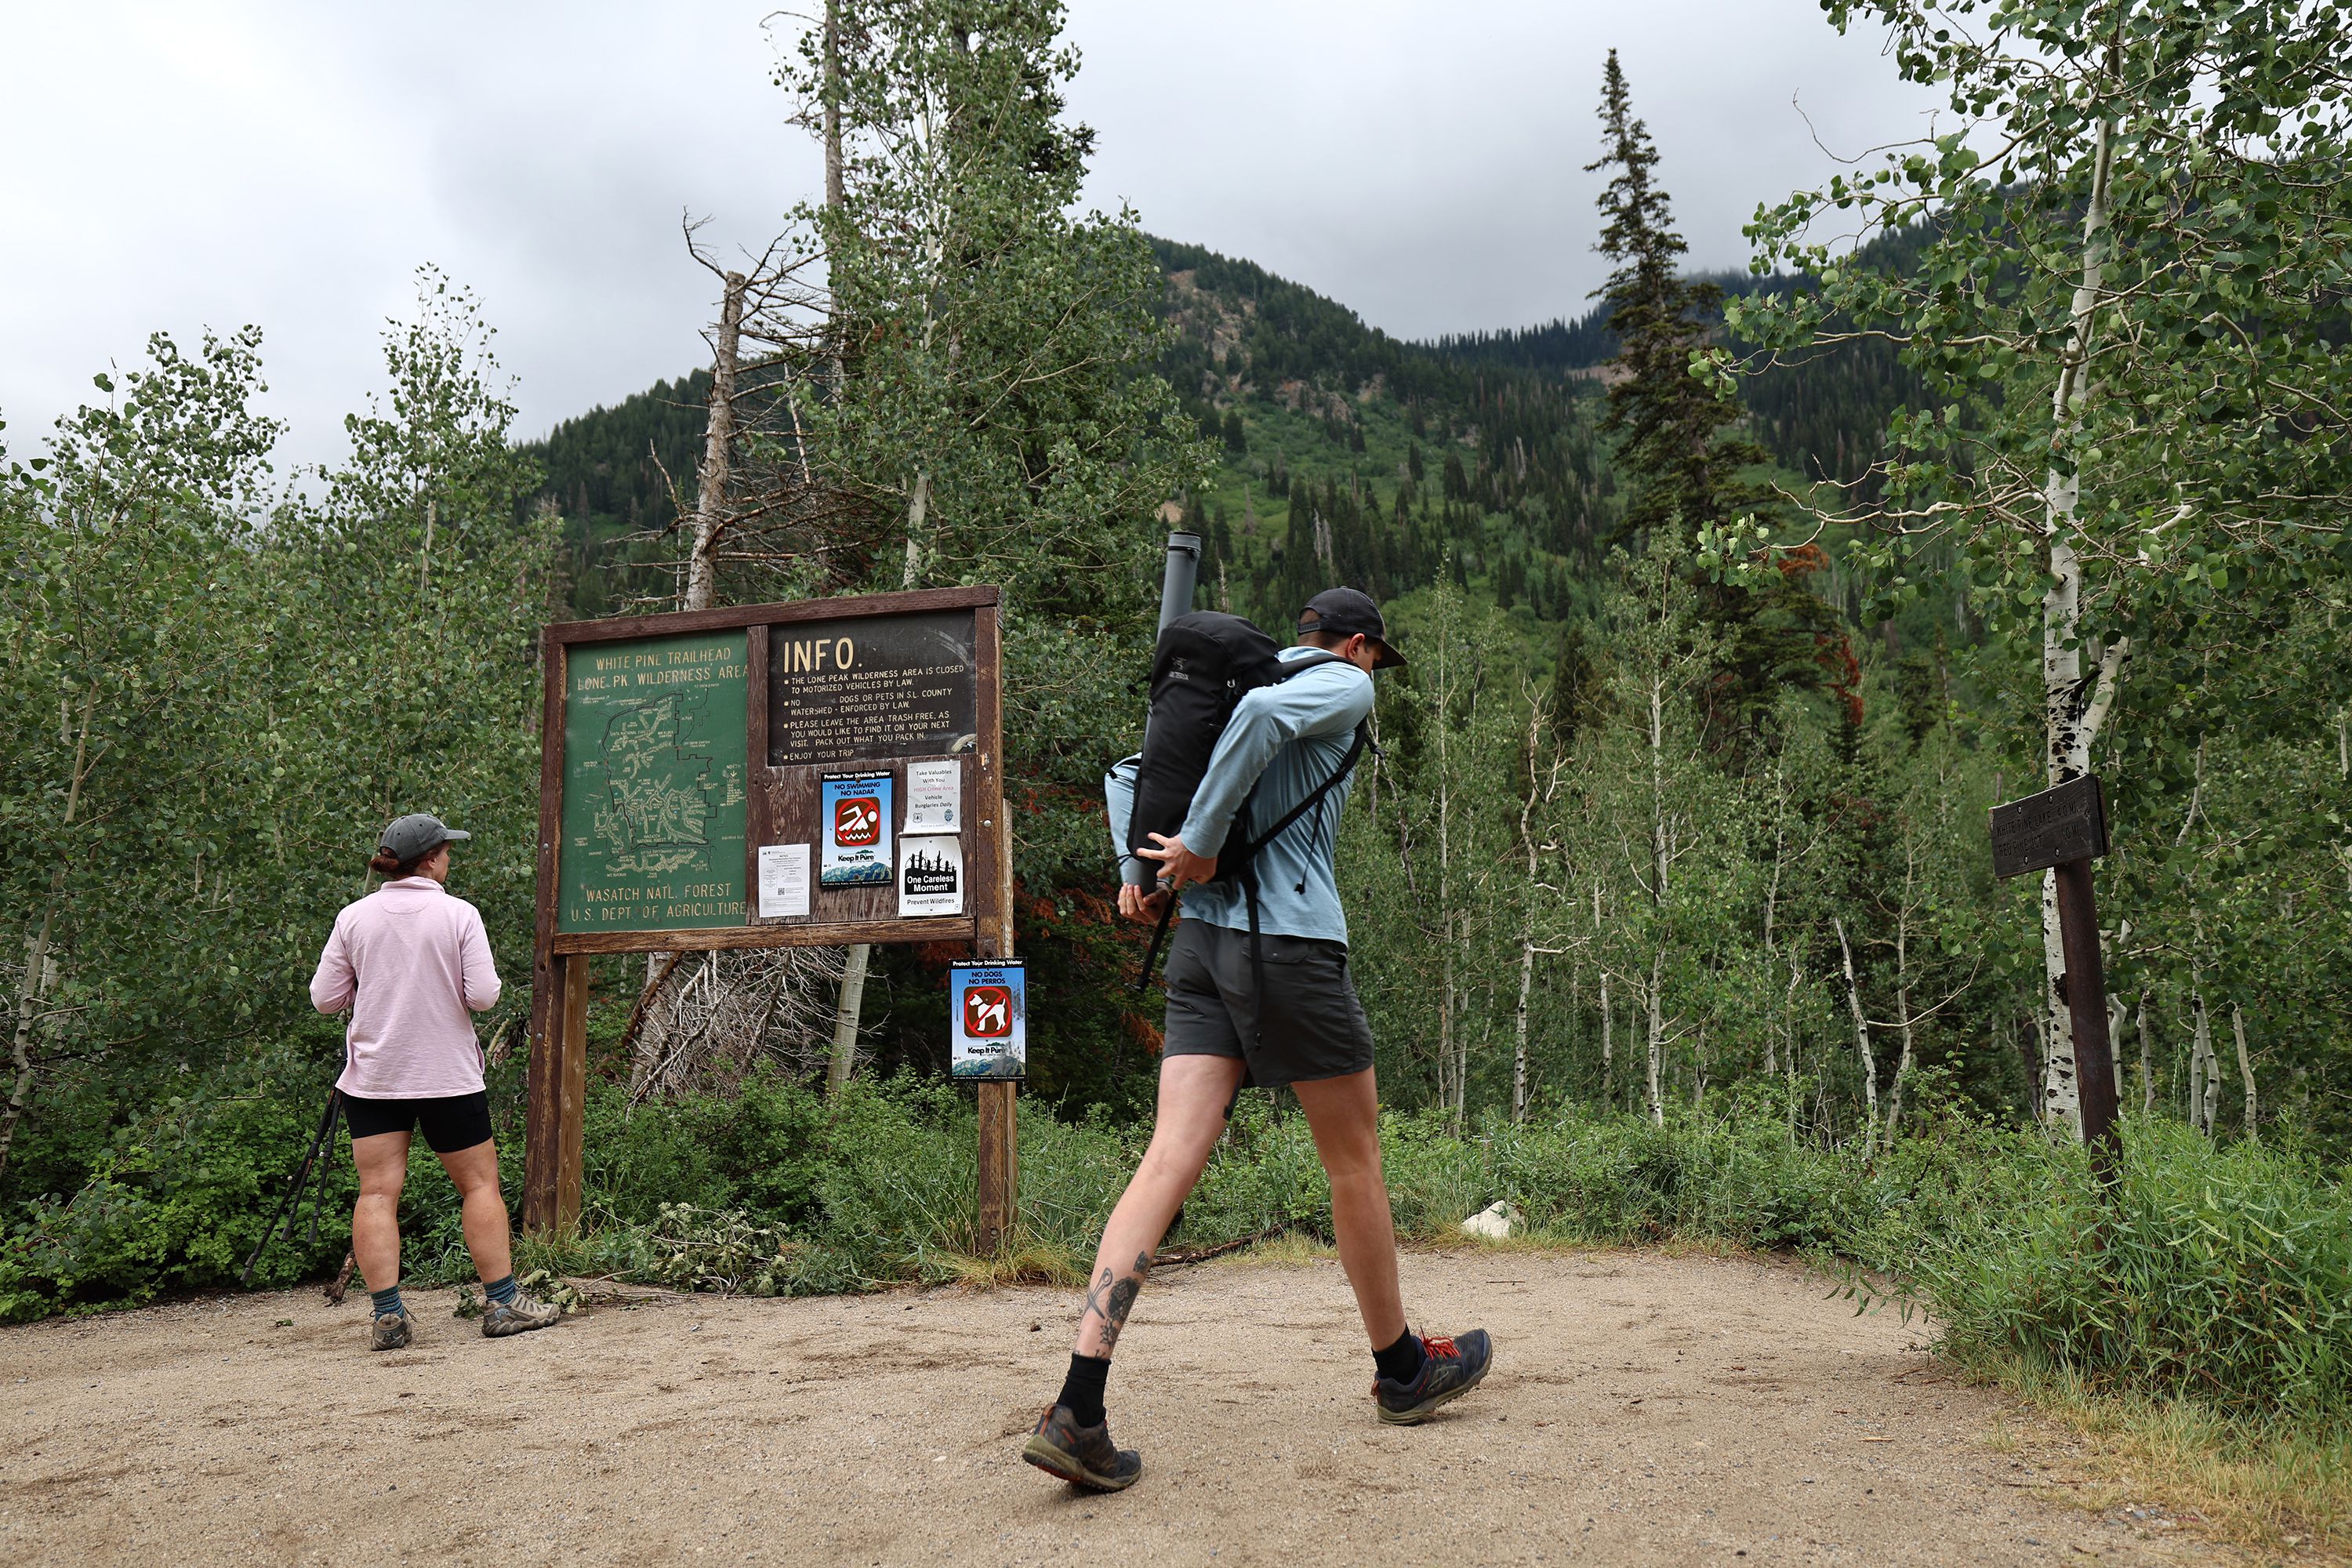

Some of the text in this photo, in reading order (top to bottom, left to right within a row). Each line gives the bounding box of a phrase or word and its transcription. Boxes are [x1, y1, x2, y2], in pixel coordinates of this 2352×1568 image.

[597, 648, 731, 670] WHITE PINE TRAILHEAD
[784, 637, 862, 673] INFO.
[578, 677, 606, 691] LONE
[637, 667, 710, 685] WILDERNESS
[718, 665, 748, 678] AREA
[852, 670, 898, 680] WILDERNESS
[936, 666, 964, 674] CLOSED
[803, 684, 843, 693] MOTORIZED
[846, 681, 881, 690] VEHICLES
[840, 695, 859, 703] DOGS
[876, 692, 894, 701] PETS
[922, 688, 953, 698] COUNTY
[791, 707, 833, 716] WATERSHED
[840, 704, 877, 713] ENFORCED
[893, 701, 910, 710] LAW.
[790, 720, 818, 729] PLEASE
[822, 718, 844, 727] LEAVE
[888, 713, 913, 722] TRASH
[909, 722, 928, 731] YOUR
[790, 739, 808, 748] VISIT.
[789, 752, 812, 760] ENJOY
[1996, 802, 2078, 837] WHITE PINE LAKE 4.0 MI.
[1999, 842, 2012, 857] RED
[2013, 838, 2029, 853] PINE
[2031, 835, 2044, 849] JCT.
[838, 855, 855, 864] Keep
[907, 876, 921, 884] One
[586, 887, 640, 902] WASATCH
[685, 883, 731, 898] FOREST
[914, 884, 948, 892] Moment
[572, 908, 594, 922] U.S.
[643, 906, 659, 919] OF
[667, 902, 746, 917] AGRICULTURE
[967, 1047, 985, 1056] Keep
